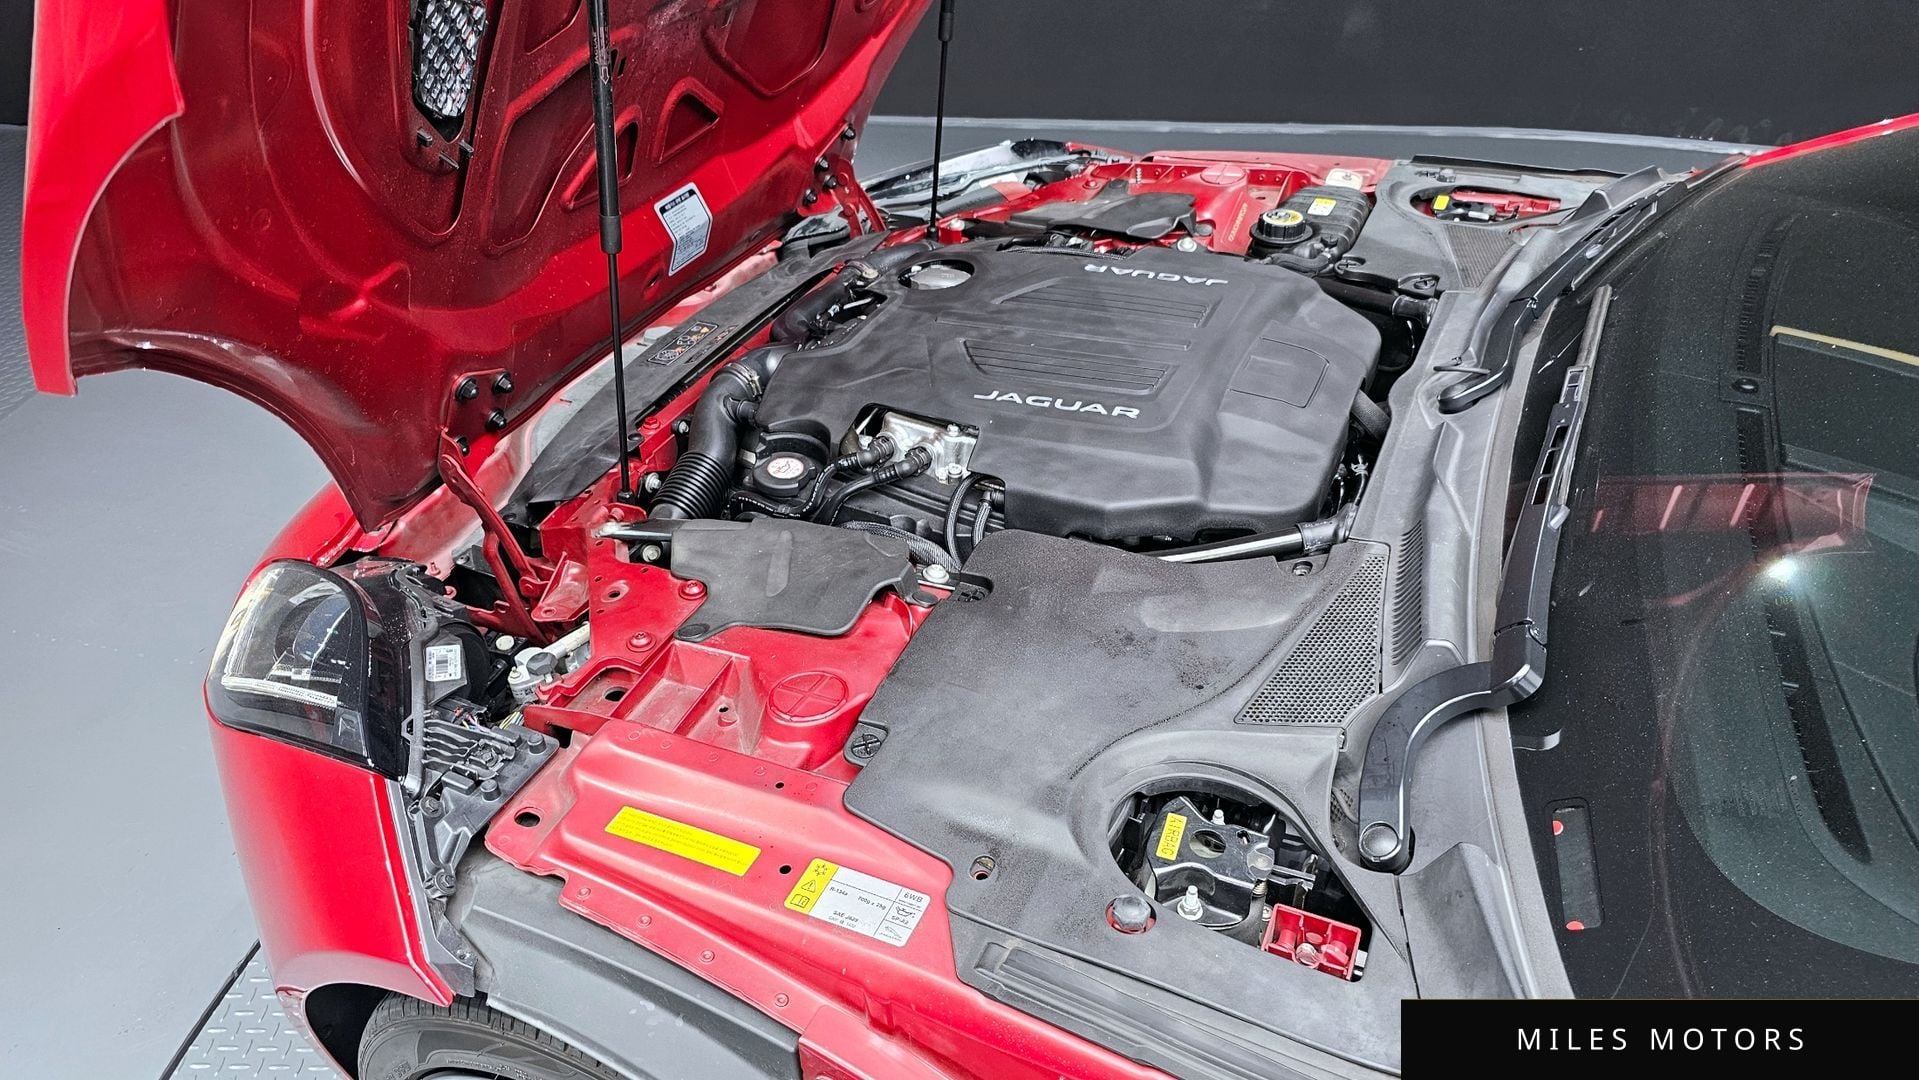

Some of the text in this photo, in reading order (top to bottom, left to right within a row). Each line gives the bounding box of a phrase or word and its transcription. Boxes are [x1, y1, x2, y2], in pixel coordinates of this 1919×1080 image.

[1084, 263, 1229, 286] JAGUAR
[973, 390, 1140, 419] JAGUAR
[1161, 815, 1183, 856] AIRBAG
